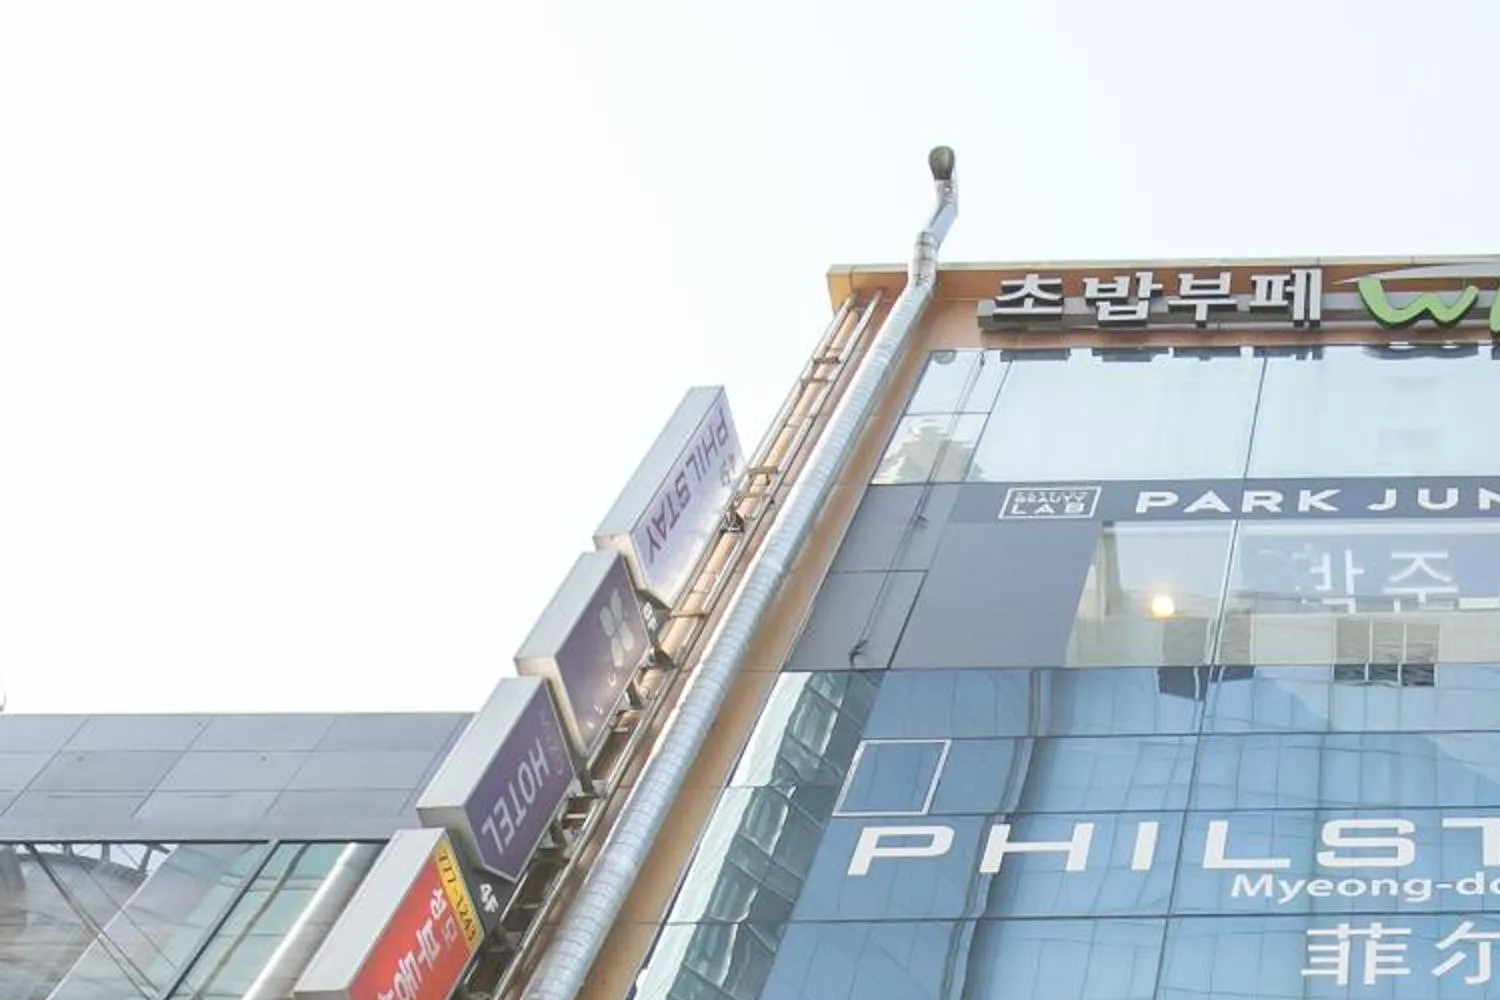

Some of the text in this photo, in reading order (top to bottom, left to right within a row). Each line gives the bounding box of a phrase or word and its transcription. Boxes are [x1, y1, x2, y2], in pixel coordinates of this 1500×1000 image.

[993, 267, 1322, 327] 초밥부페
[646, 408, 729, 563] PHILSTAY
[1133, 487, 1344, 514] PARK
[1011, 502, 1085, 515] LAB
[480, 740, 551, 855] HOTEL
[479, 883, 499, 914] 4F
